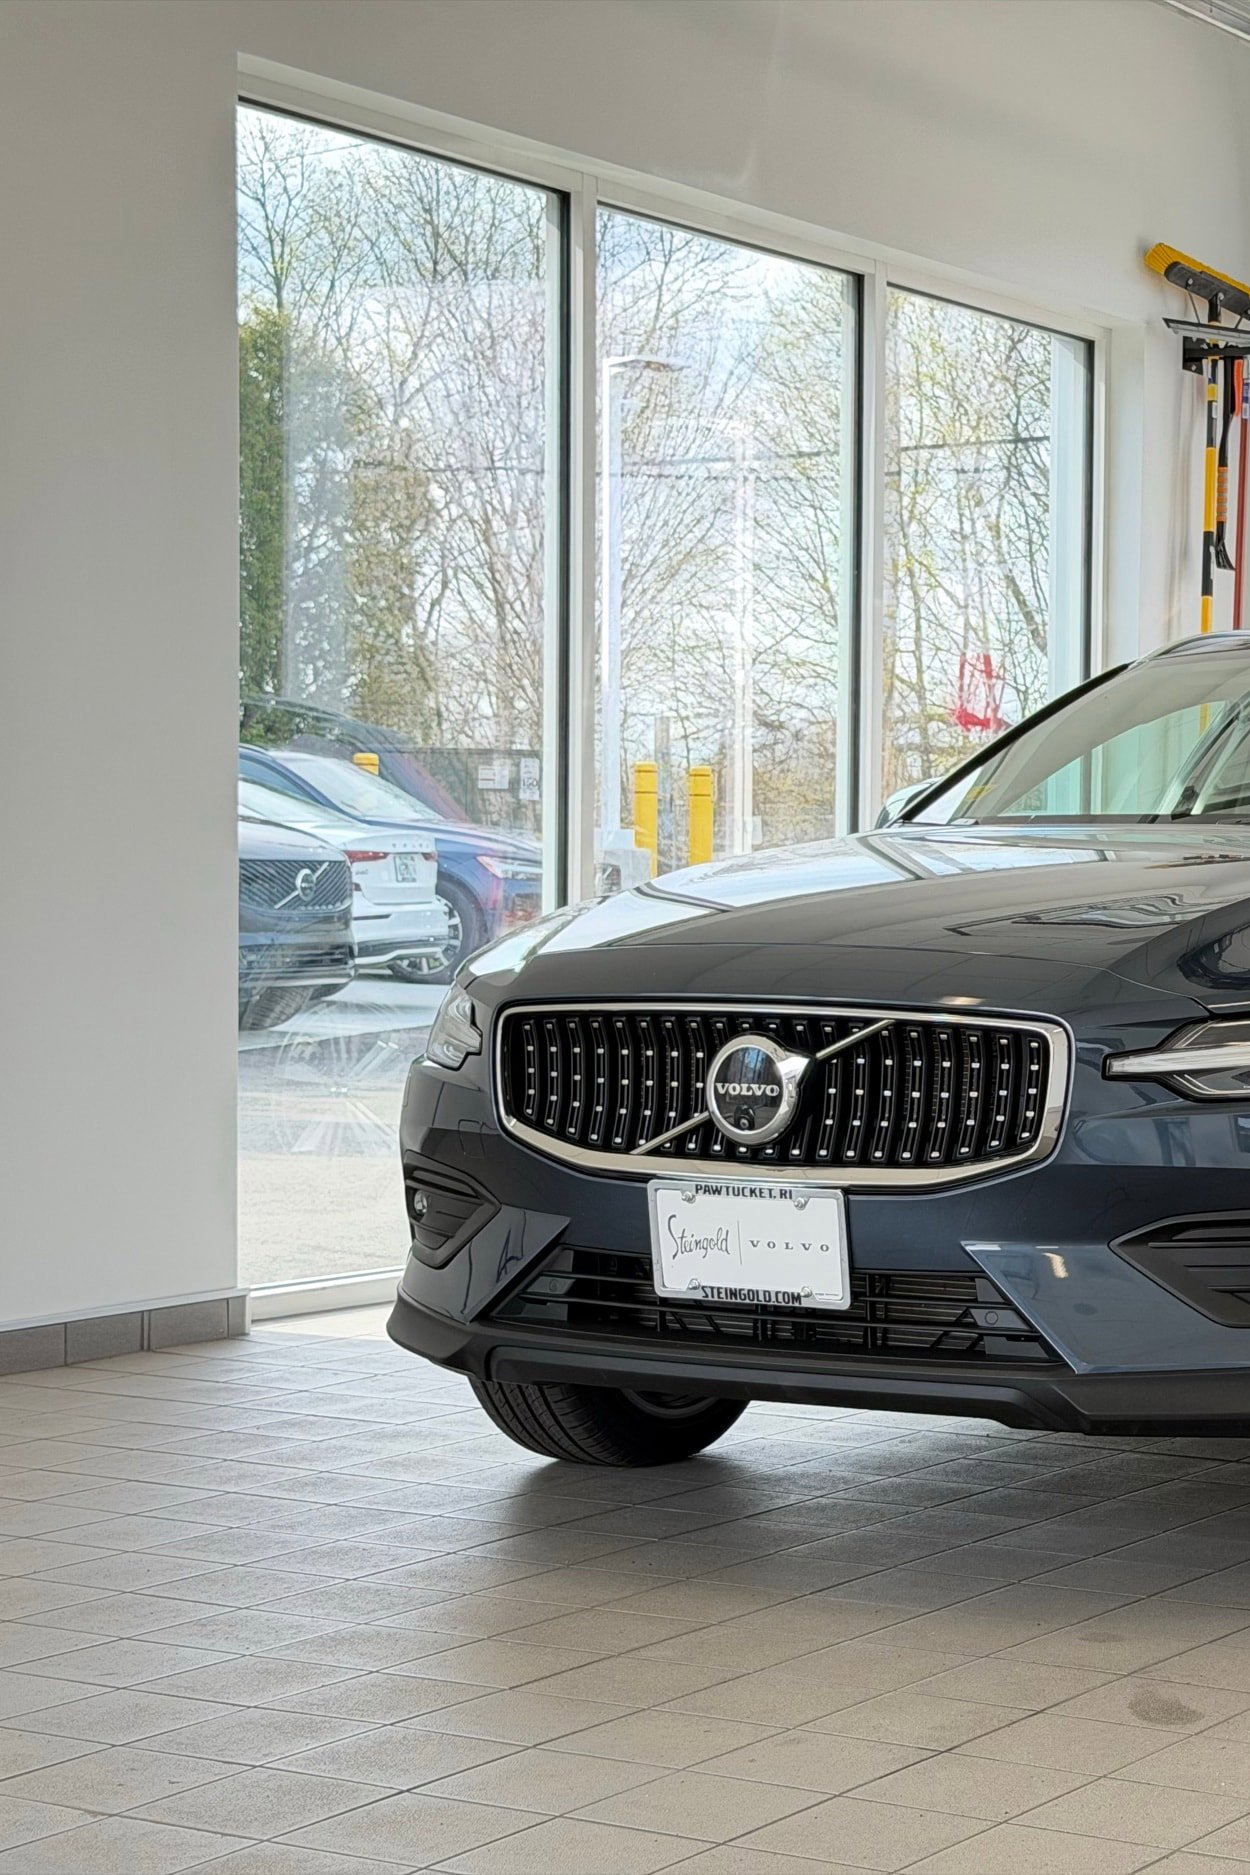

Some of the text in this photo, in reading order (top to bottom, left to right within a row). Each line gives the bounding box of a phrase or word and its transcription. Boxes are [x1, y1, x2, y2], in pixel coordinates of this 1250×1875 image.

[715, 1082, 780, 1096] VOLVO
[779, 1189, 793, 1200] RI
[667, 1214, 731, 1260] Steingold
[749, 1239, 830, 1252] VOLVO
[701, 1285, 802, 1306] STEINGOLD.COM
